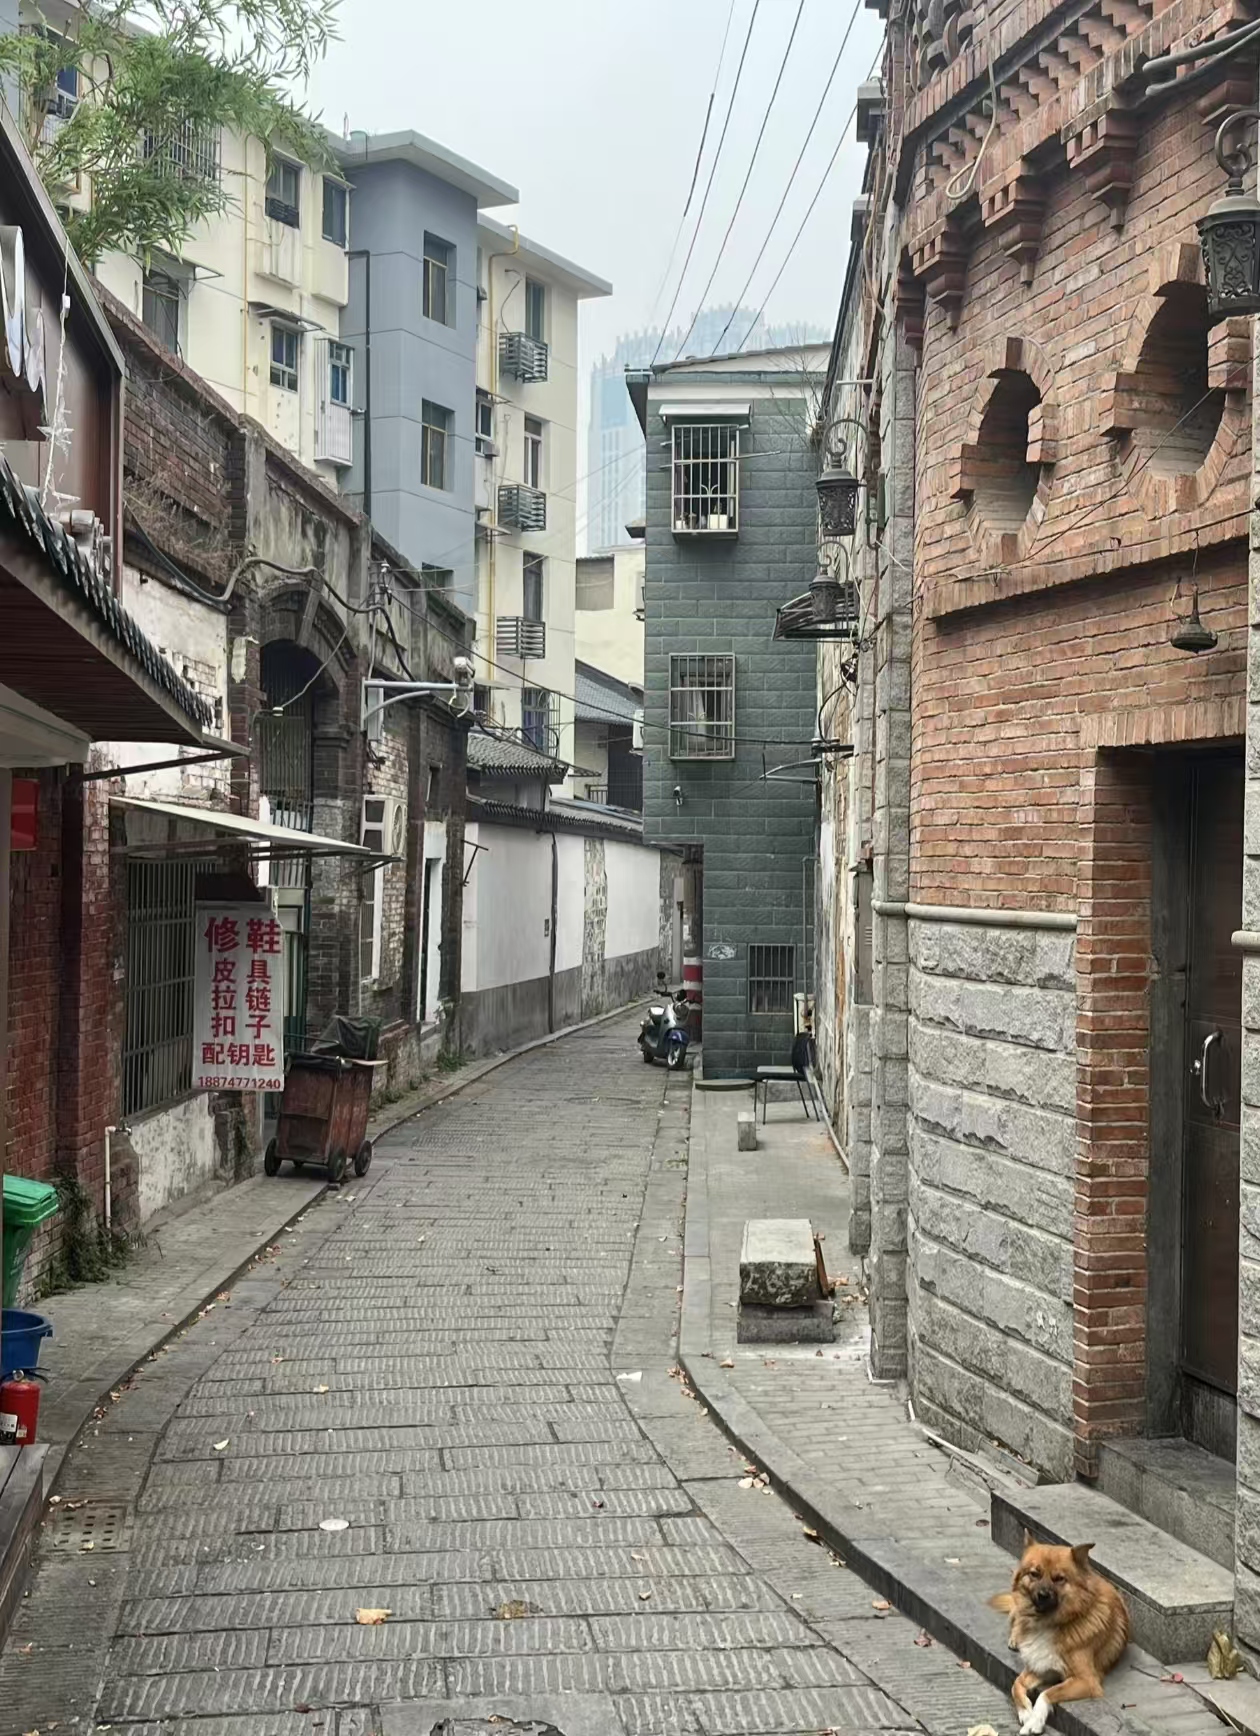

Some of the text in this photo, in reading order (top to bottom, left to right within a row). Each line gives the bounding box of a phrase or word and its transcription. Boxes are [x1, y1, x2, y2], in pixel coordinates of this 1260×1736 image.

[204, 917, 281, 953] 修鞋
[212, 958, 271, 985] 皮具
[212, 985, 271, 1012] 拉链
[211, 1012, 271, 1039] 扣子
[202, 1042, 276, 1067] 配钥匙
[198, 1076, 281, 1089] 18874771240
